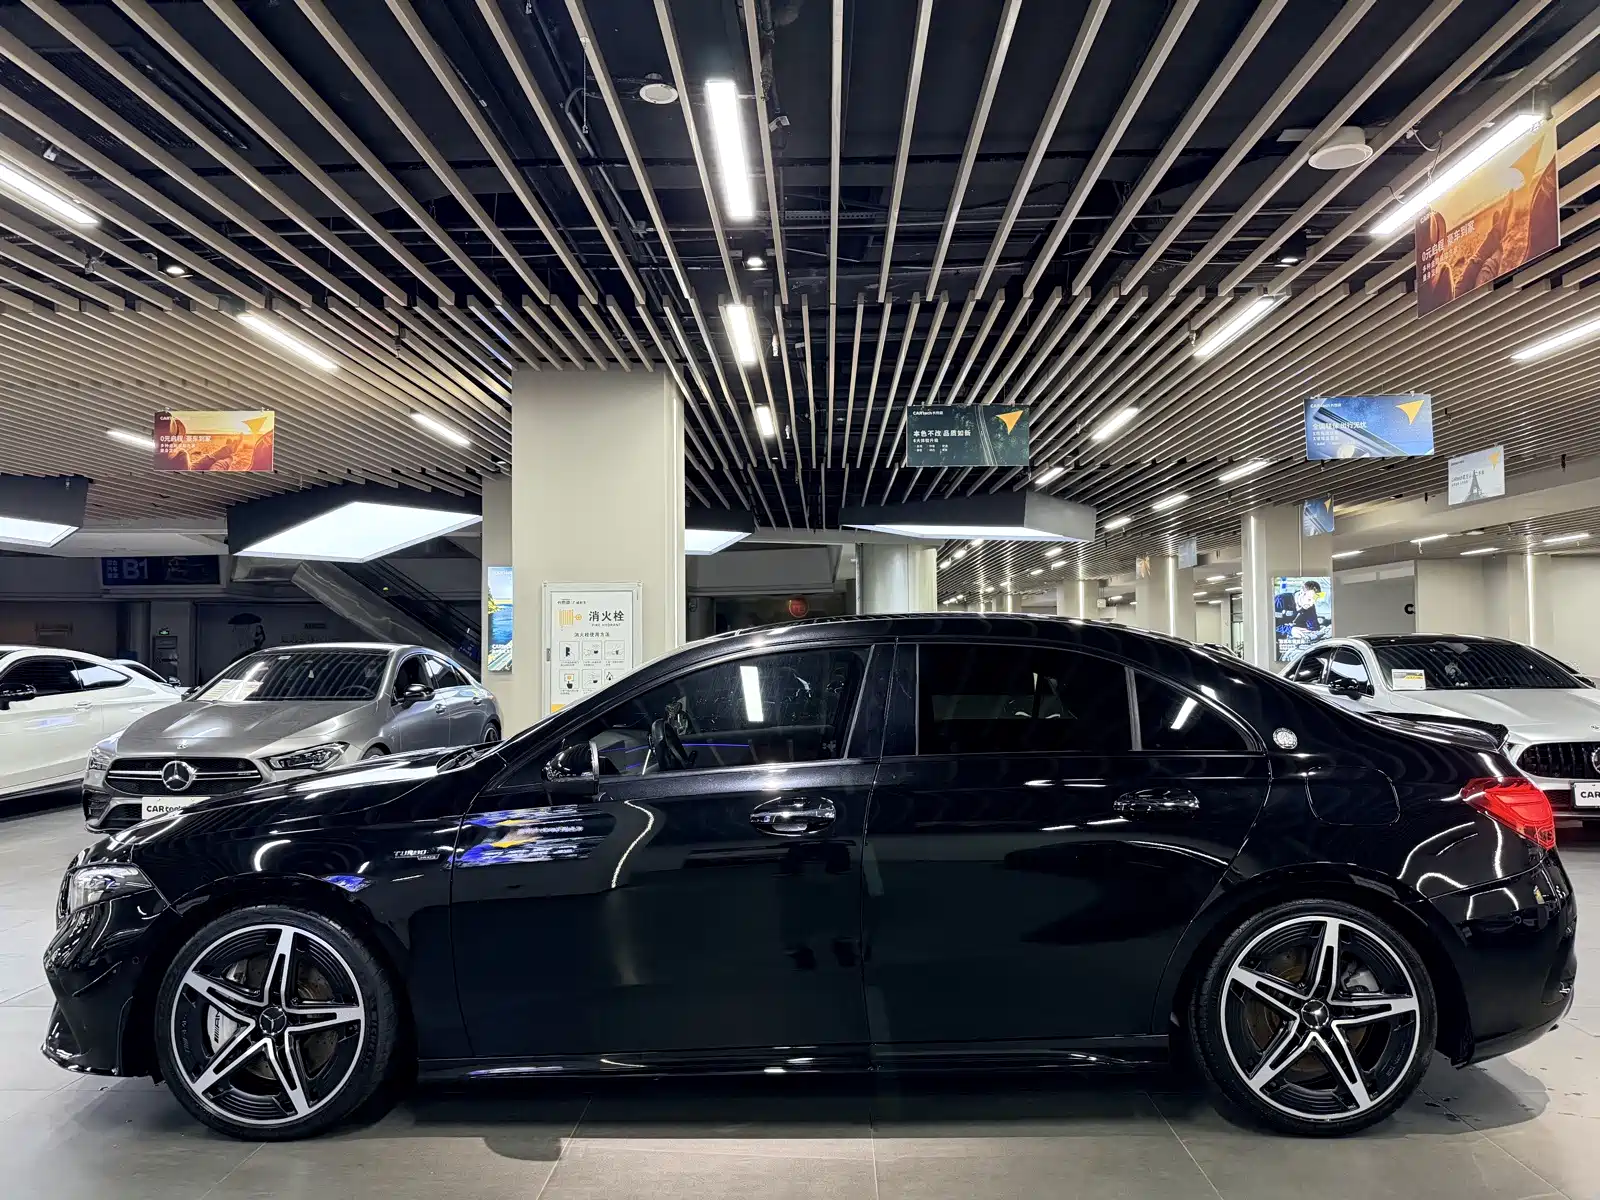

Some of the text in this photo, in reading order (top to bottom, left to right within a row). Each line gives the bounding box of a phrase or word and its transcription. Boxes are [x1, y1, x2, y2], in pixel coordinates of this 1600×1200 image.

[913, 429, 972, 437] 本色不改 品质如新
[122, 558, 148, 580] B1
[588, 610, 625, 622] 消火栓
